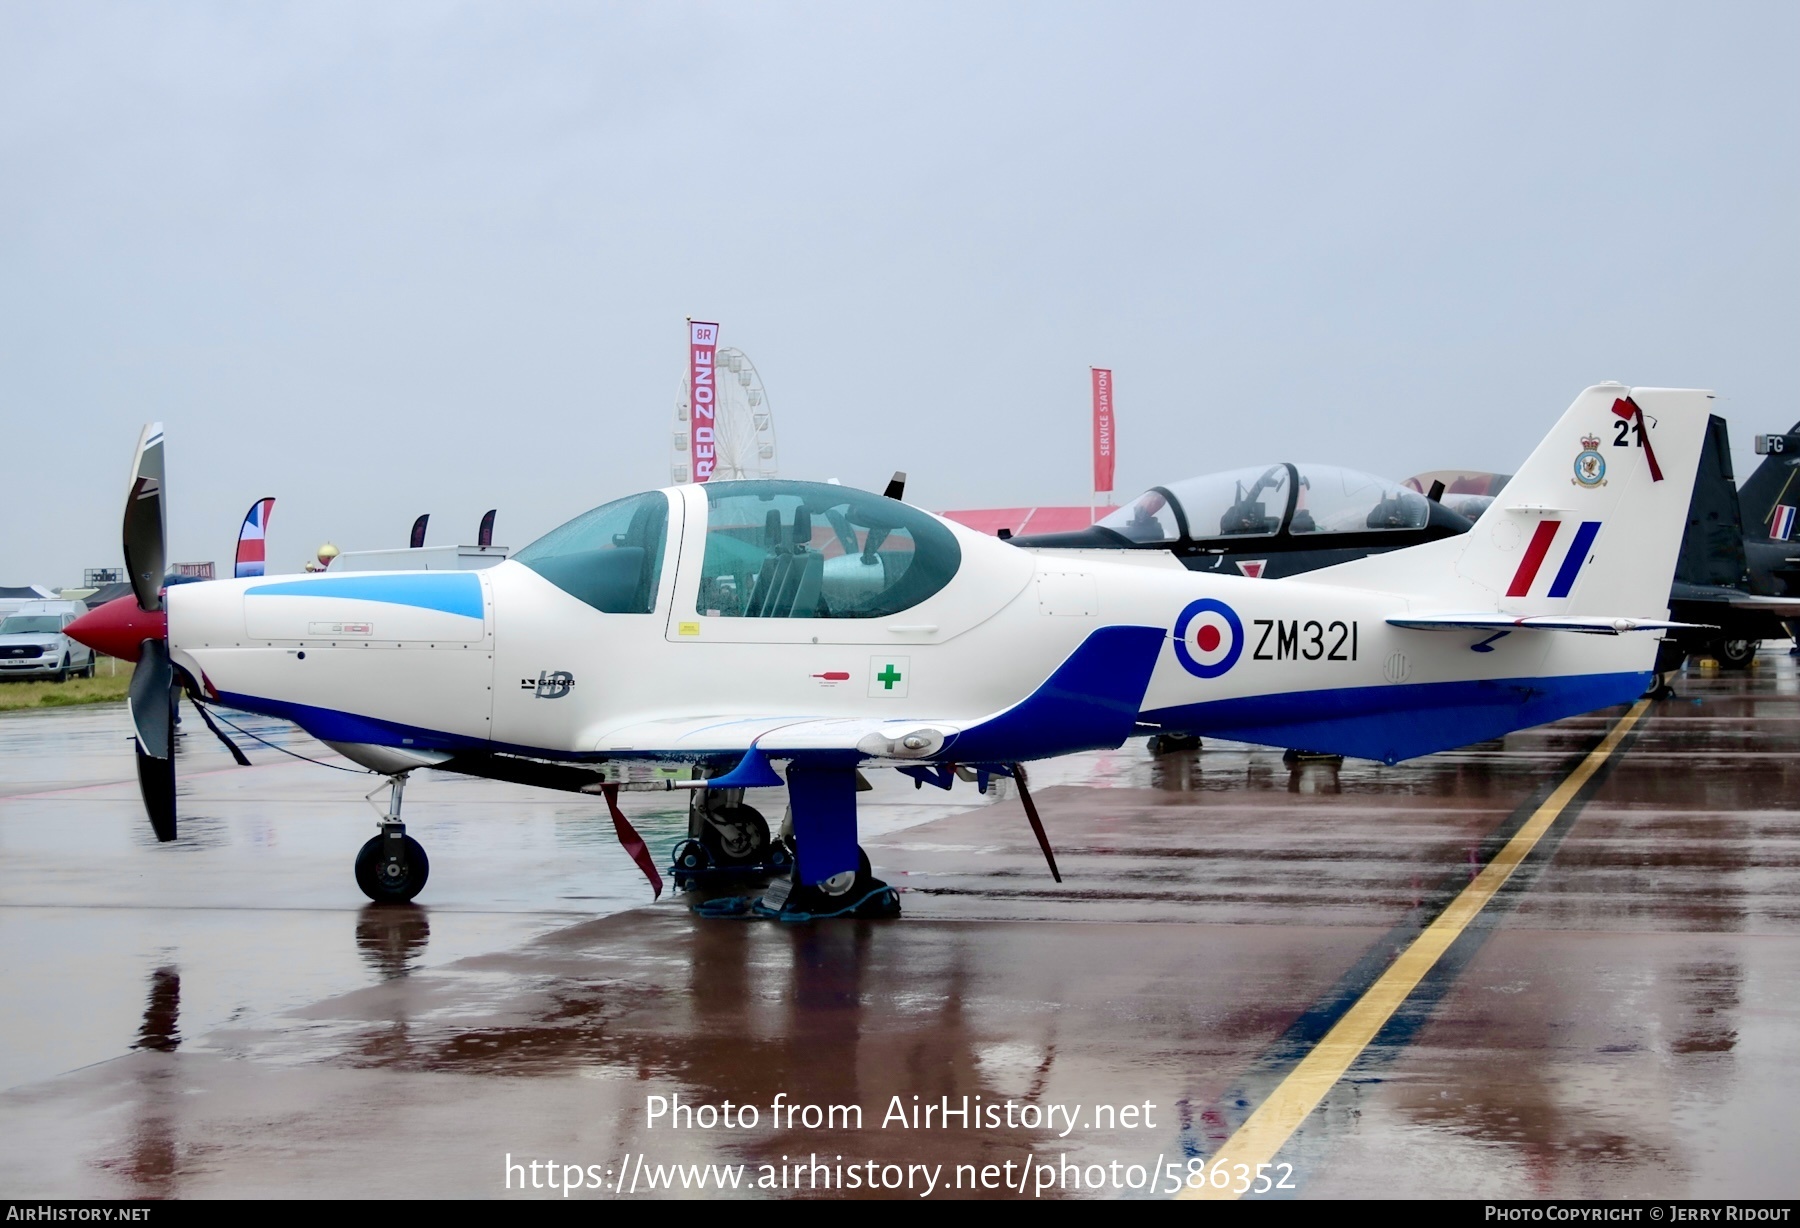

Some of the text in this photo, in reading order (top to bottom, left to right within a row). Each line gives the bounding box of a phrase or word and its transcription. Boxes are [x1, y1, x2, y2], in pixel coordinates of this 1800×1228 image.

[697, 328, 711, 340] 8R
[695, 350, 715, 477] RED ZONE
[1098, 371, 1110, 456] SERVICE STATION
[1613, 420, 1643, 447] 21
[1766, 436, 1784, 453] FG
[1253, 620, 1358, 661] ZM321
